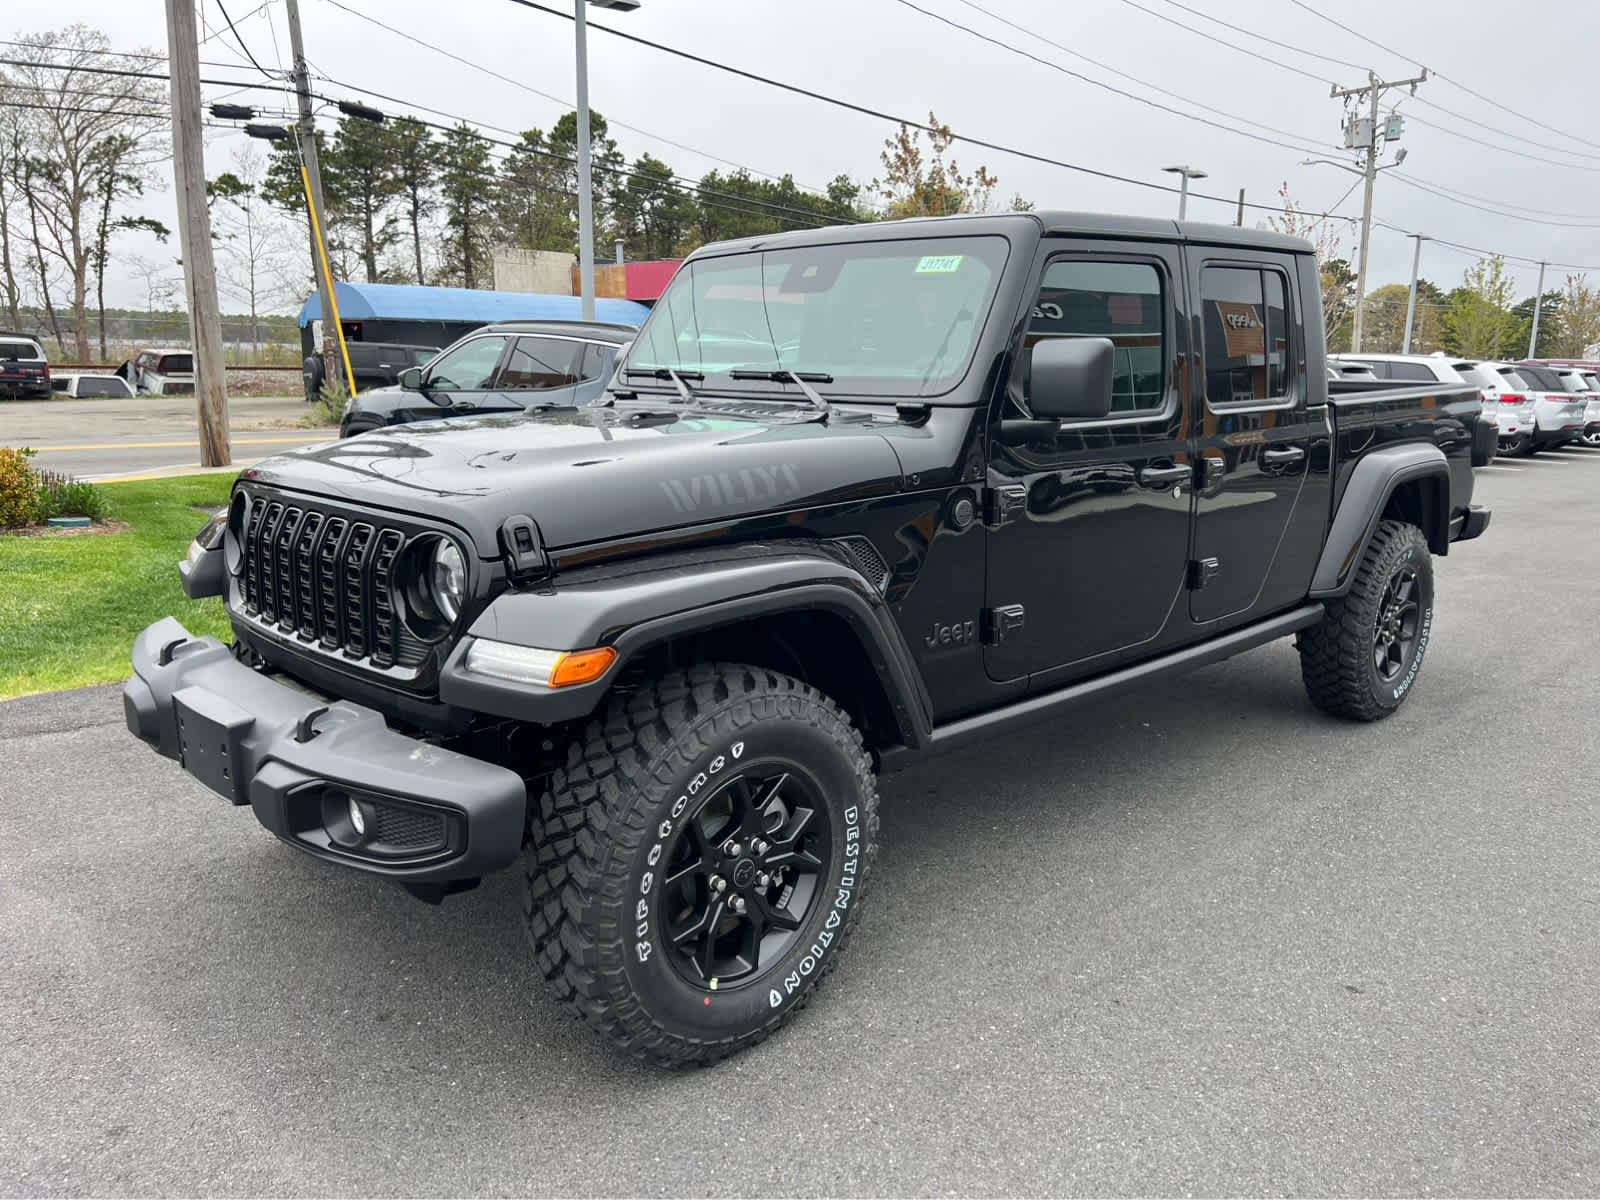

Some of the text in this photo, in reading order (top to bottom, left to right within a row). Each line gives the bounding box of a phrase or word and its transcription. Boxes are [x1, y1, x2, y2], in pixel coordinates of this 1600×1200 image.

[658, 463, 801, 512] WILLYS
[923, 621, 976, 648] Jeep
[784, 806, 859, 994] DESTINATION
